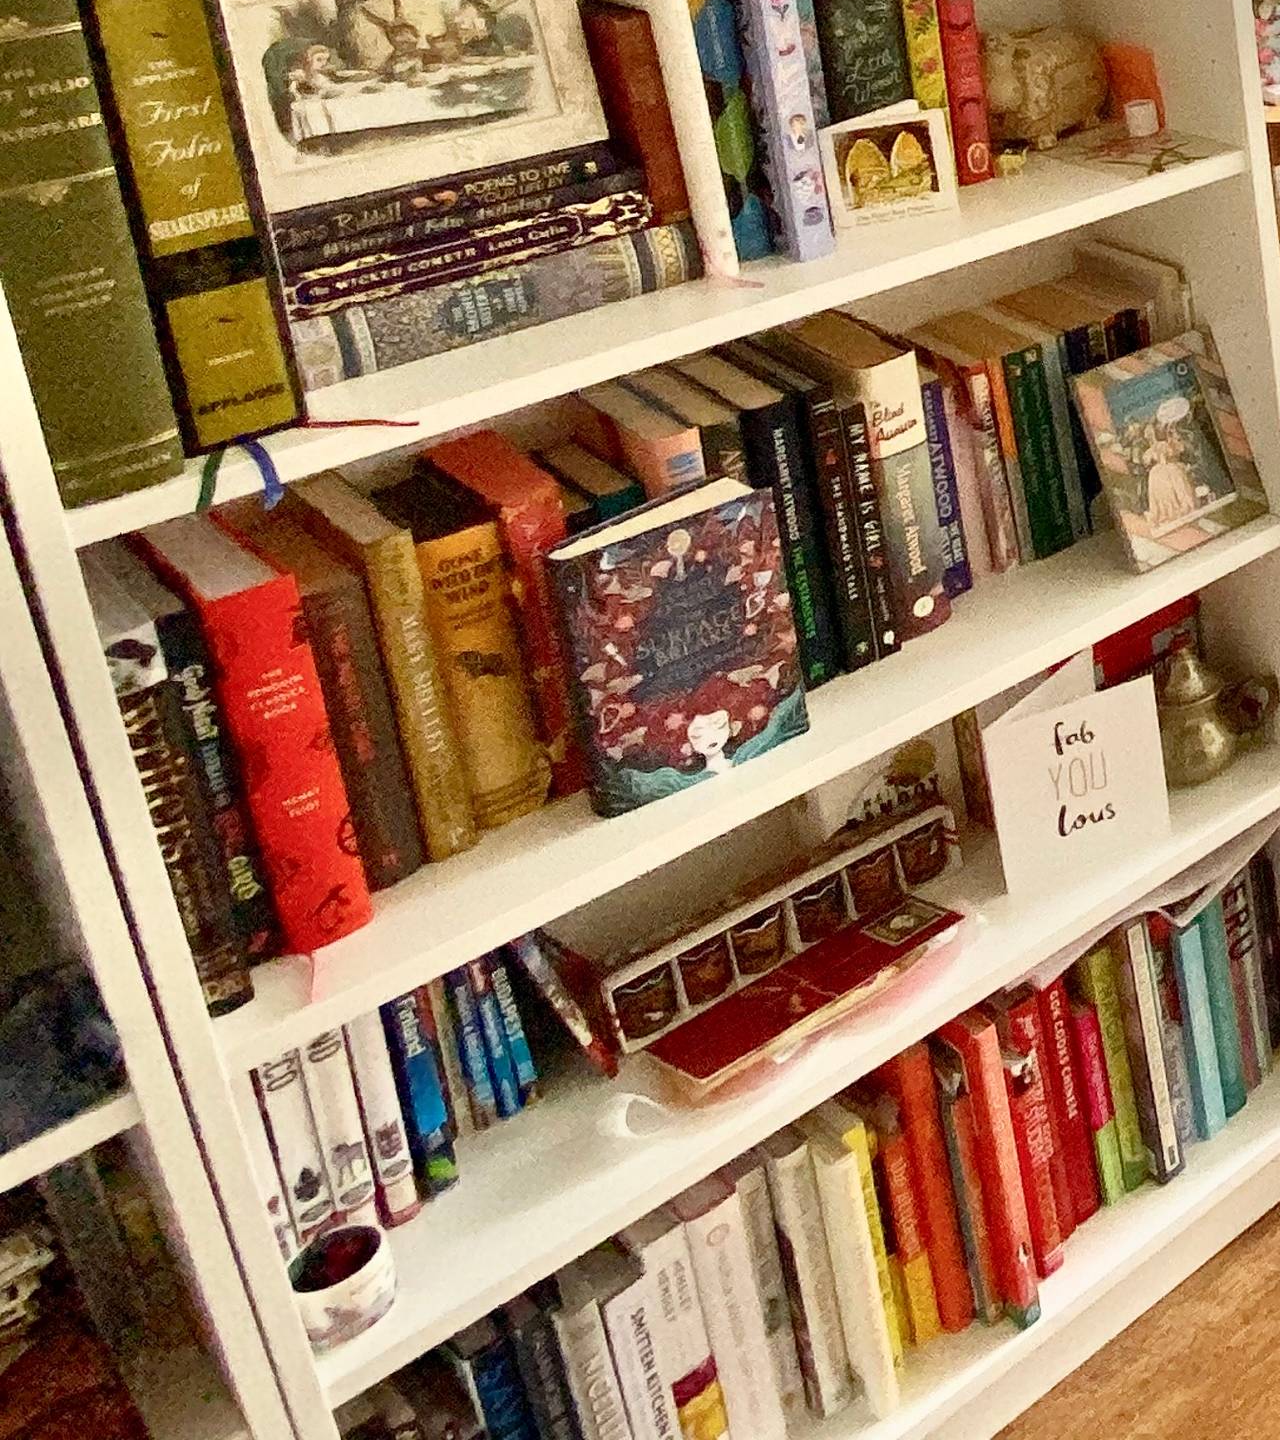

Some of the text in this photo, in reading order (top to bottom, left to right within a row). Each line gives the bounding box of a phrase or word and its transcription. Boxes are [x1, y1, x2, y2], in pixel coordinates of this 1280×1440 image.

[138, 95, 213, 127] First
[147, 132, 221, 167] Folio
[179, 173, 210, 201] of
[463, 172, 517, 197] POEMS
[518, 167, 540, 184] TO
[872, 403, 906, 428] Blind
[773, 428, 792, 490] MARGARET
[928, 440, 953, 519] ATWOOD
[850, 423, 882, 552] MY NAME IS GIRL
[782, 494, 801, 540] ATWOOD
[896, 463, 927, 576] Margaret Atwood
[402, 615, 426, 664] MARY
[1054, 720, 1095, 755] fab
[1048, 750, 1107, 800] YOU
[1058, 803, 1116, 837] lous
[395, 995, 427, 1057] Finland
[1049, 1019, 1073, 1065] COOKS
[627, 1306, 673, 1436] SMITTEN KITCHEN
